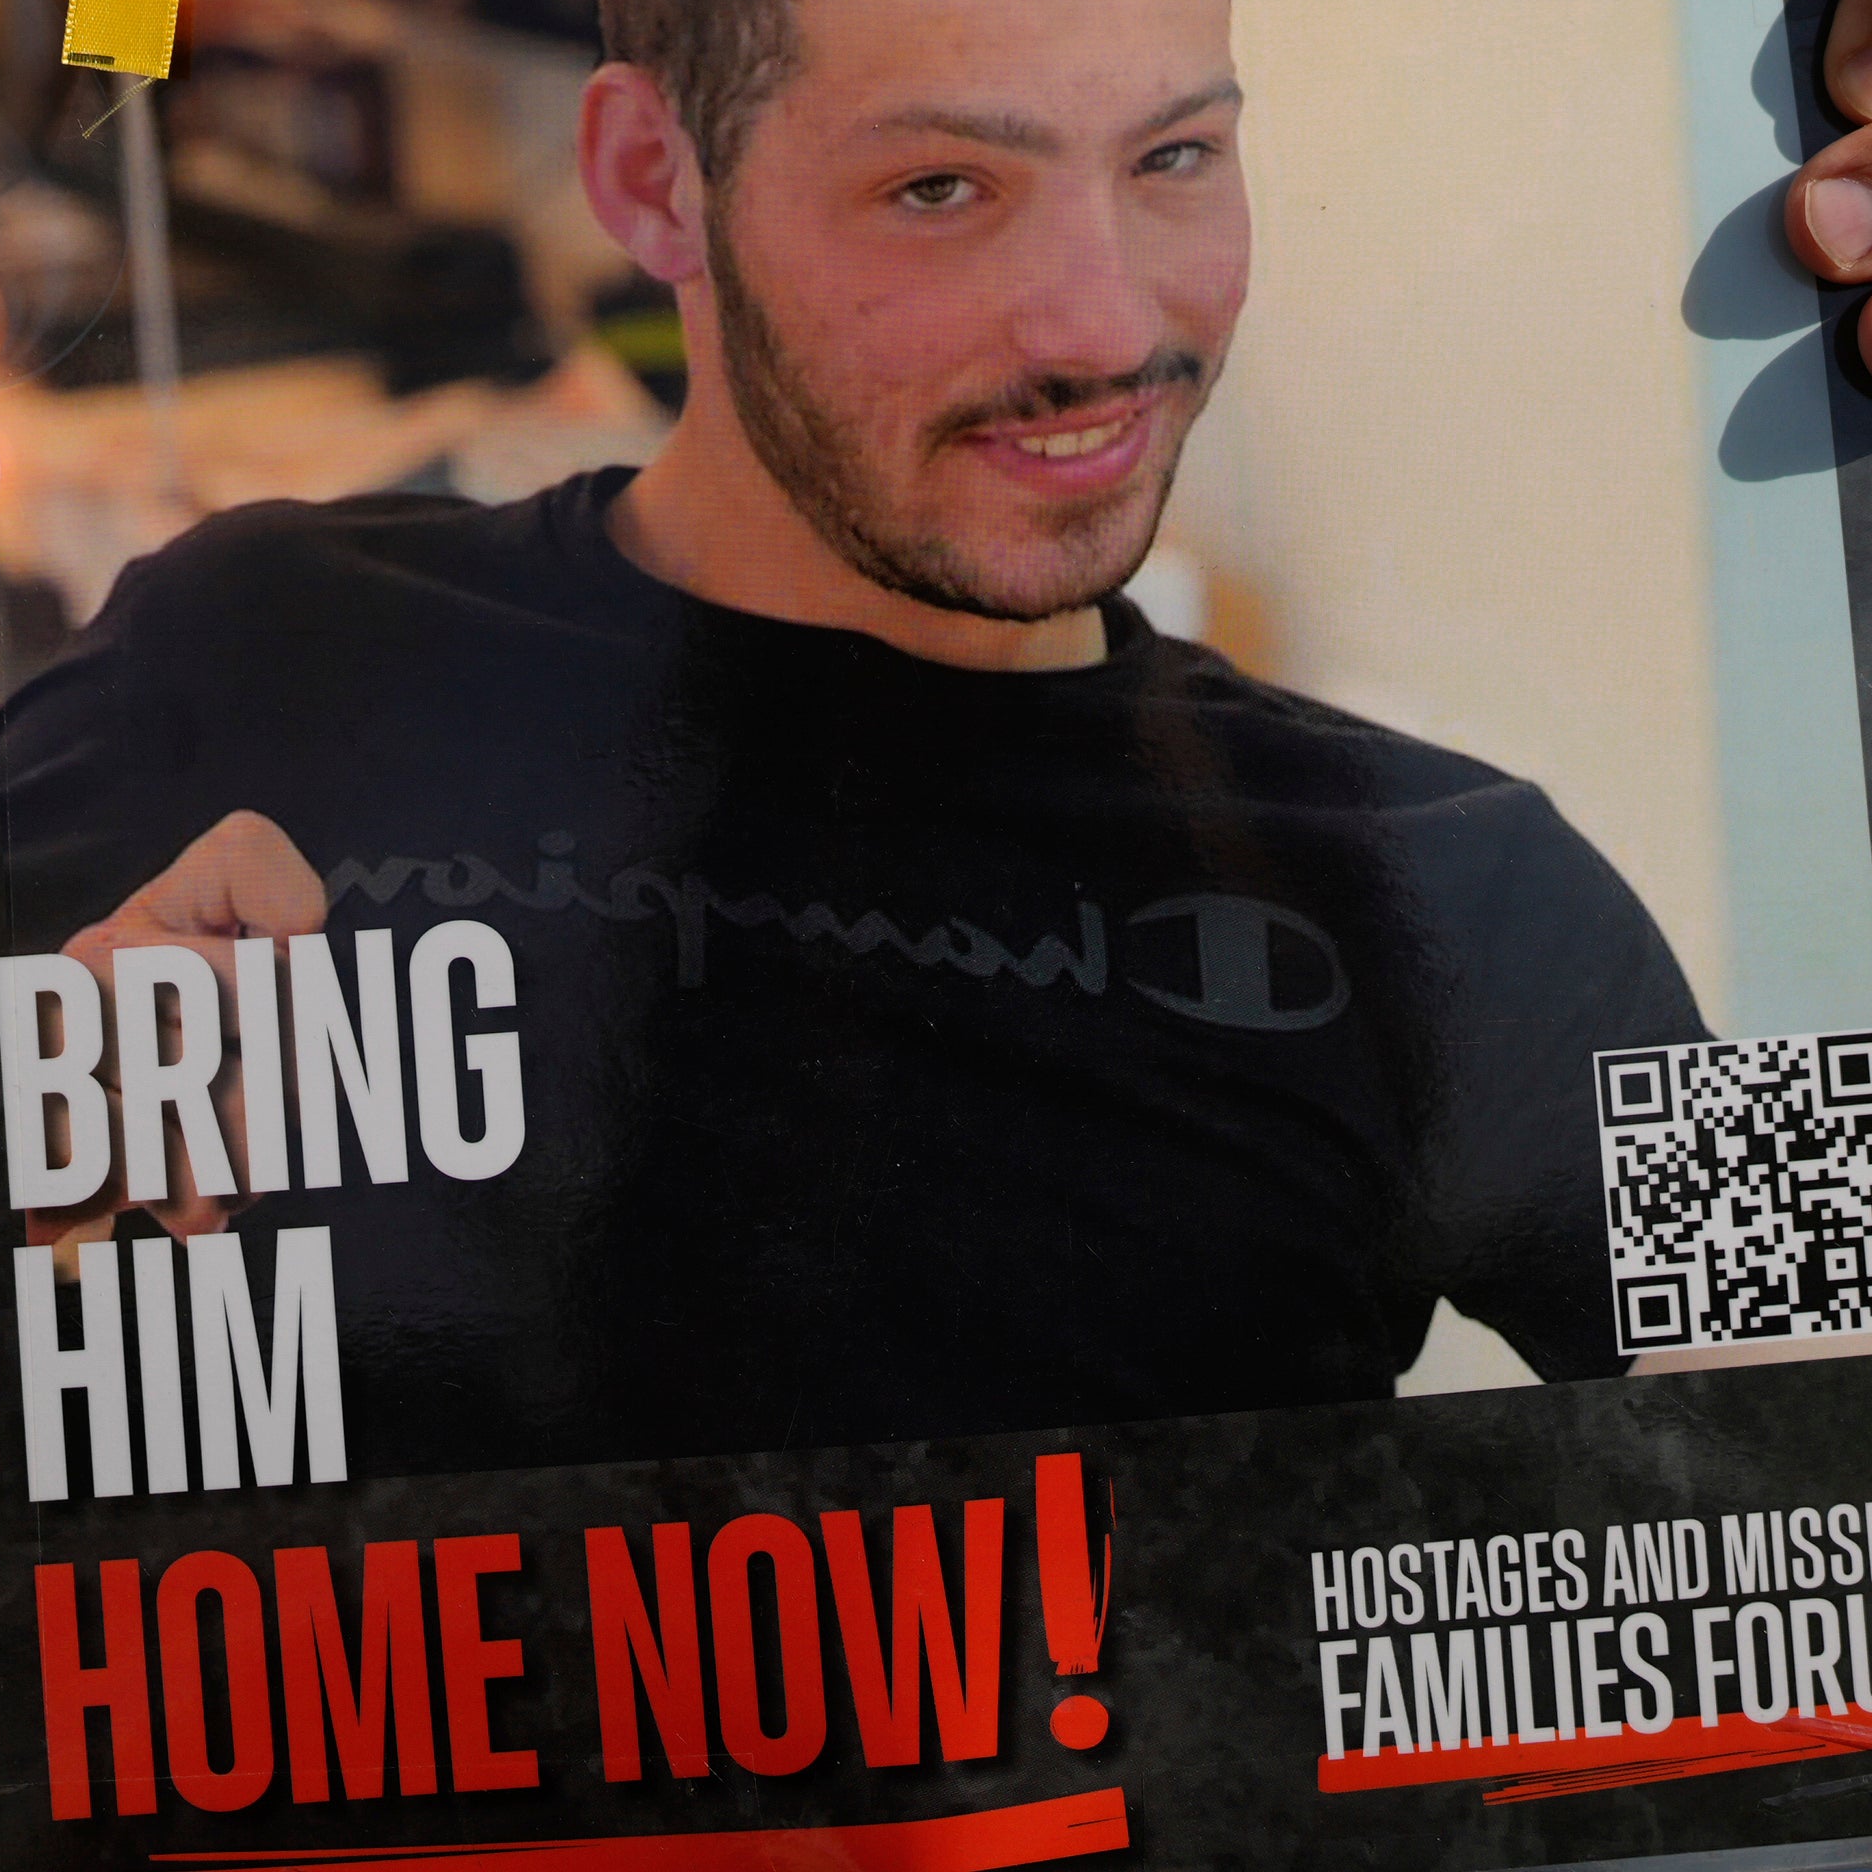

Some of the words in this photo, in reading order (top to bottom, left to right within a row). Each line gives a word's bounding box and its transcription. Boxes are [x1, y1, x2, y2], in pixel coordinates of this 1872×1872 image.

[13, 1226, 348, 1503] HIM
[33, 1533, 540, 1822] HOME
[584, 1453, 1117, 1783] NOW!
[1310, 1527, 1589, 1632] HOSTAGES
[1602, 1519, 1711, 1606] AND
[1319, 1612, 1675, 1762] FAMILIES
